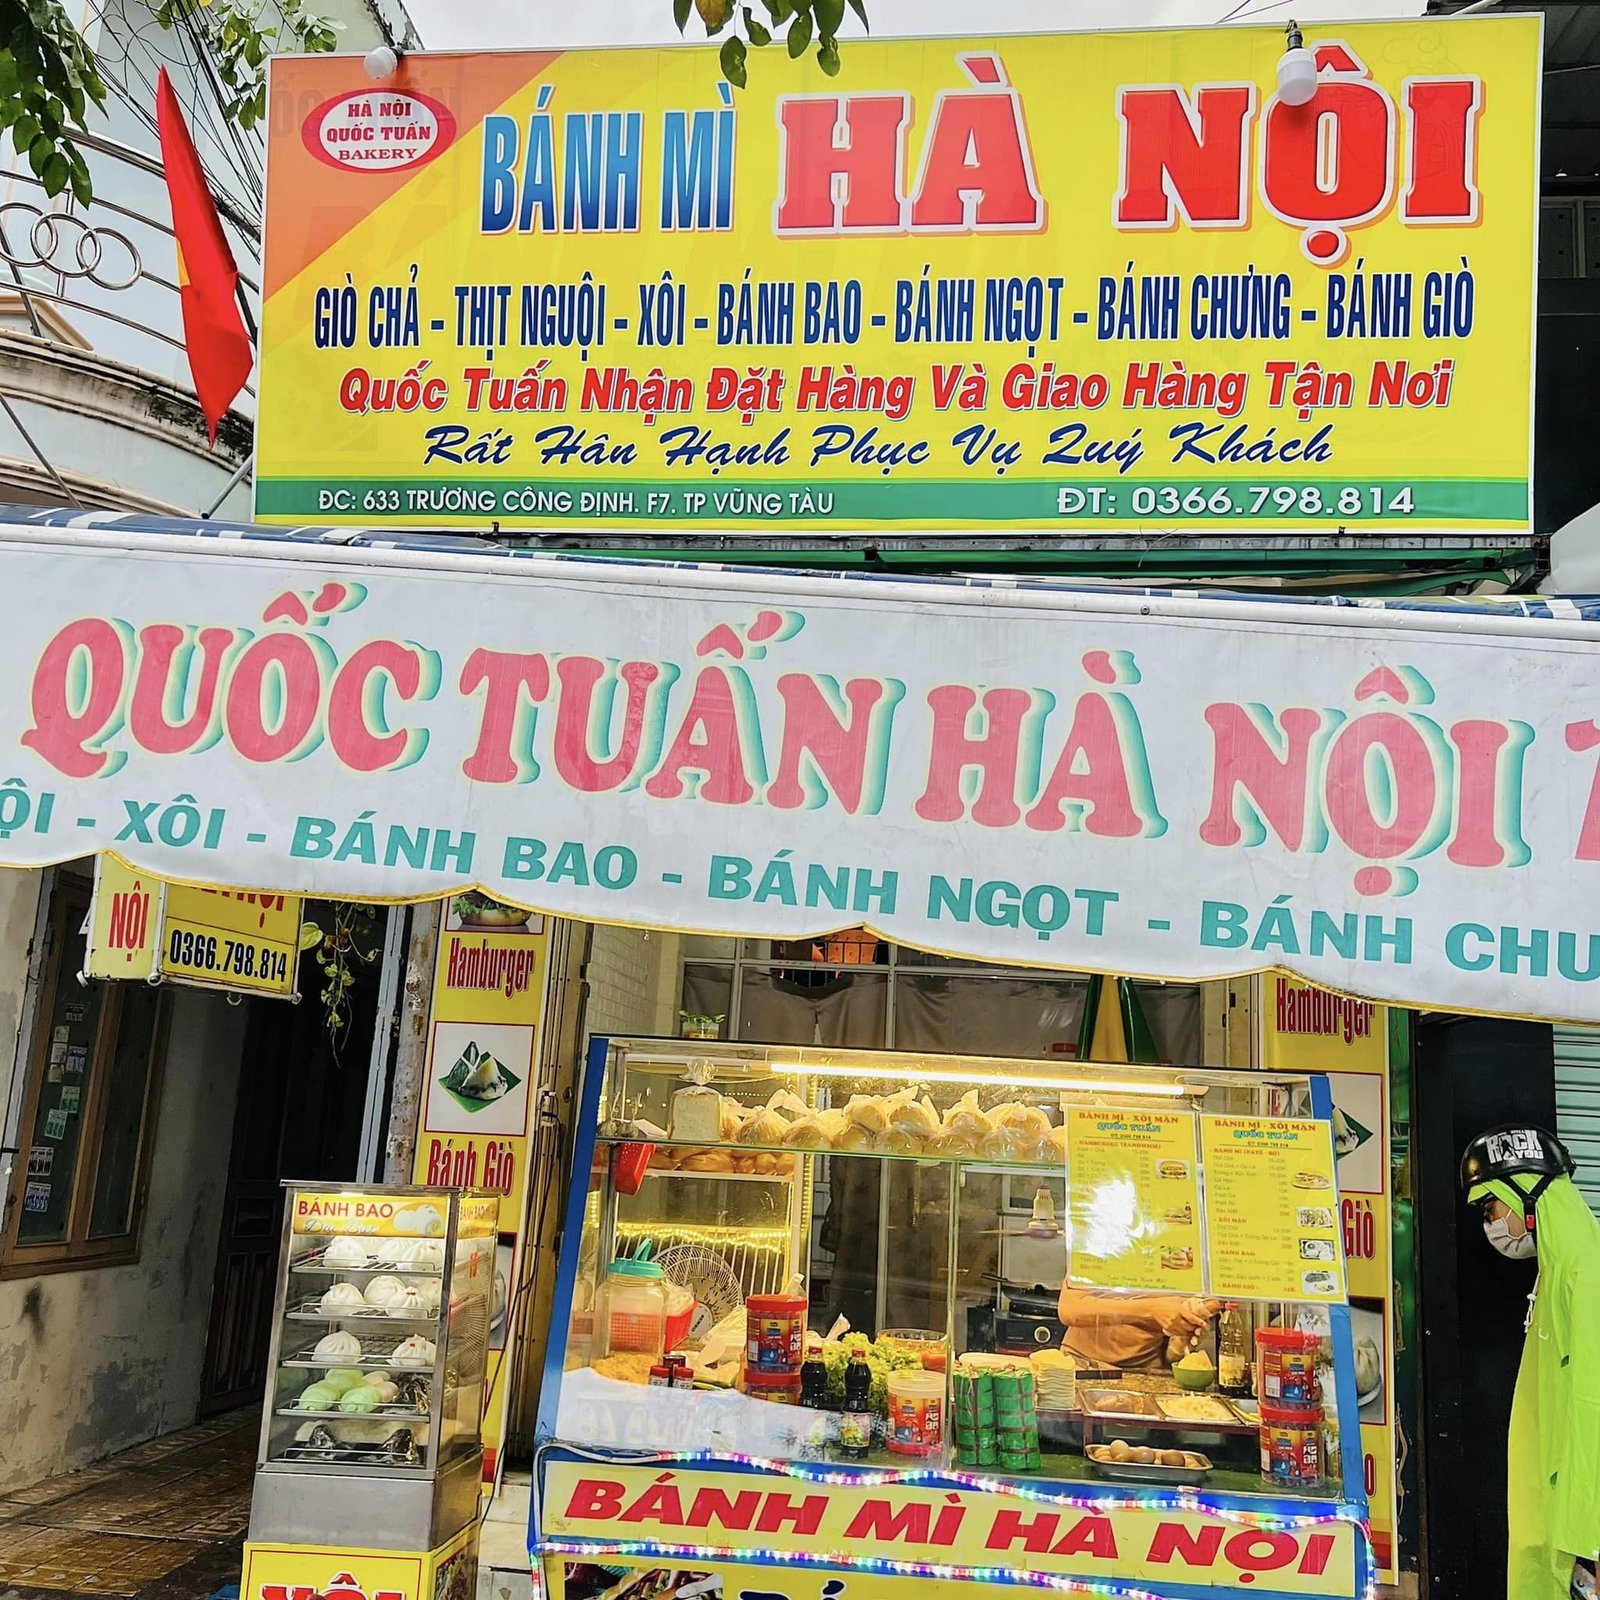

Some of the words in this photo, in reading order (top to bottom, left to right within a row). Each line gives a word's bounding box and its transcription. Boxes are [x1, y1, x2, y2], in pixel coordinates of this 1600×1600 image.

[326, 122, 374, 143] QUỐC
[380, 120, 431, 141] TUẤN
[348, 99, 372, 117] HÀ
[379, 98, 412, 120] NỘI
[338, 147, 418, 161] BAKERY
[481, 84, 643, 234] BÁNH
[660, 81, 739, 232] MÌ
[774, 50, 1046, 234] HÀ
[1112, 39, 1483, 265] NỘI
[315, 274, 356, 349] GIÒ
[368, 263, 420, 348] CHẢ
[454, 285, 513, 361] THỊT
[520, 271, 606, 361] NGUỘI
[637, 270, 685, 347] XÔI
[716, 268, 795, 346] BÁNH
[803, 279, 862, 345] BAO
[894, 264, 974, 344] BÁNH
[984, 278, 1064, 359] NGỌT
[1098, 261, 1179, 341] BÁNH
[1190, 264, 1292, 339] CHƯNG
[1326, 255, 1410, 339] BÁNH
[1423, 255, 1474, 338] GIÒ
[339, 359, 448, 415] Quốc
[463, 359, 567, 414] Tuấn
[579, 366, 695, 426] Nhận
[705, 366, 784, 427] Đặt
[799, 364, 915, 421] Hàng
[930, 362, 986, 411] Và
[1002, 361, 1109, 411] Giao
[1121, 360, 1247, 418] Hàng
[1264, 360, 1352, 421] Tận
[1367, 358, 1454, 409] Nơi
[423, 425, 514, 467] Rất
[537, 425, 638, 467] Hân
[659, 425, 792, 476] Hạnh
[810, 424, 930, 476] Phục
[950, 422, 1022, 476] Vụ
[1041, 422, 1145, 476] Quý
[1169, 422, 1336, 465] Khách
[318, 490, 358, 510] ĐC:
[363, 489, 400, 511] 633
[406, 487, 497, 511] TRƯƠNG
[502, 483, 576, 513] CÔNG
[580, 490, 640, 519] ĐỊNH.
[647, 491, 677, 515] F7.
[683, 491, 708, 514] TP
[713, 484, 793, 514] VŨNG
[795, 485, 834, 514] TÀU
[1057, 487, 1118, 514] ĐT:
[1131, 485, 1415, 515] 0366.798.814
[20, 581, 441, 779] QUỐC
[460, 610, 904, 815] TUẤN
[914, 650, 1168, 838] HÀ
[1199, 664, 1535, 897] NỘI
[114, 794, 226, 849] XÔI
[290, 811, 476, 874] BÁNH
[501, 836, 638, 890] BAO
[708, 852, 899, 915] BÁNH
[927, 874, 1118, 941] NGỌT
[1200, 893, 1414, 965] BÁNH
[108, 880, 150, 962] NỘI
[169, 929, 288, 983] 0366.798.814
[446, 937, 535, 999] Hamburger
[1276, 978, 1375, 1046] Hamburger
[426, 1138, 477, 1188] Bánh
[482, 1141, 515, 1198] Giò
[1515, 1149, 1544, 1160] YOU
[298, 1196, 349, 1217] BÁNH
[355, 1202, 394, 1218] BAO
[1341, 1198, 1376, 1261] Giò
[564, 1474, 829, 1535] BÁNH
[844, 1493, 967, 1546] MÌ
[985, 1506, 1120, 1562] HÀ
